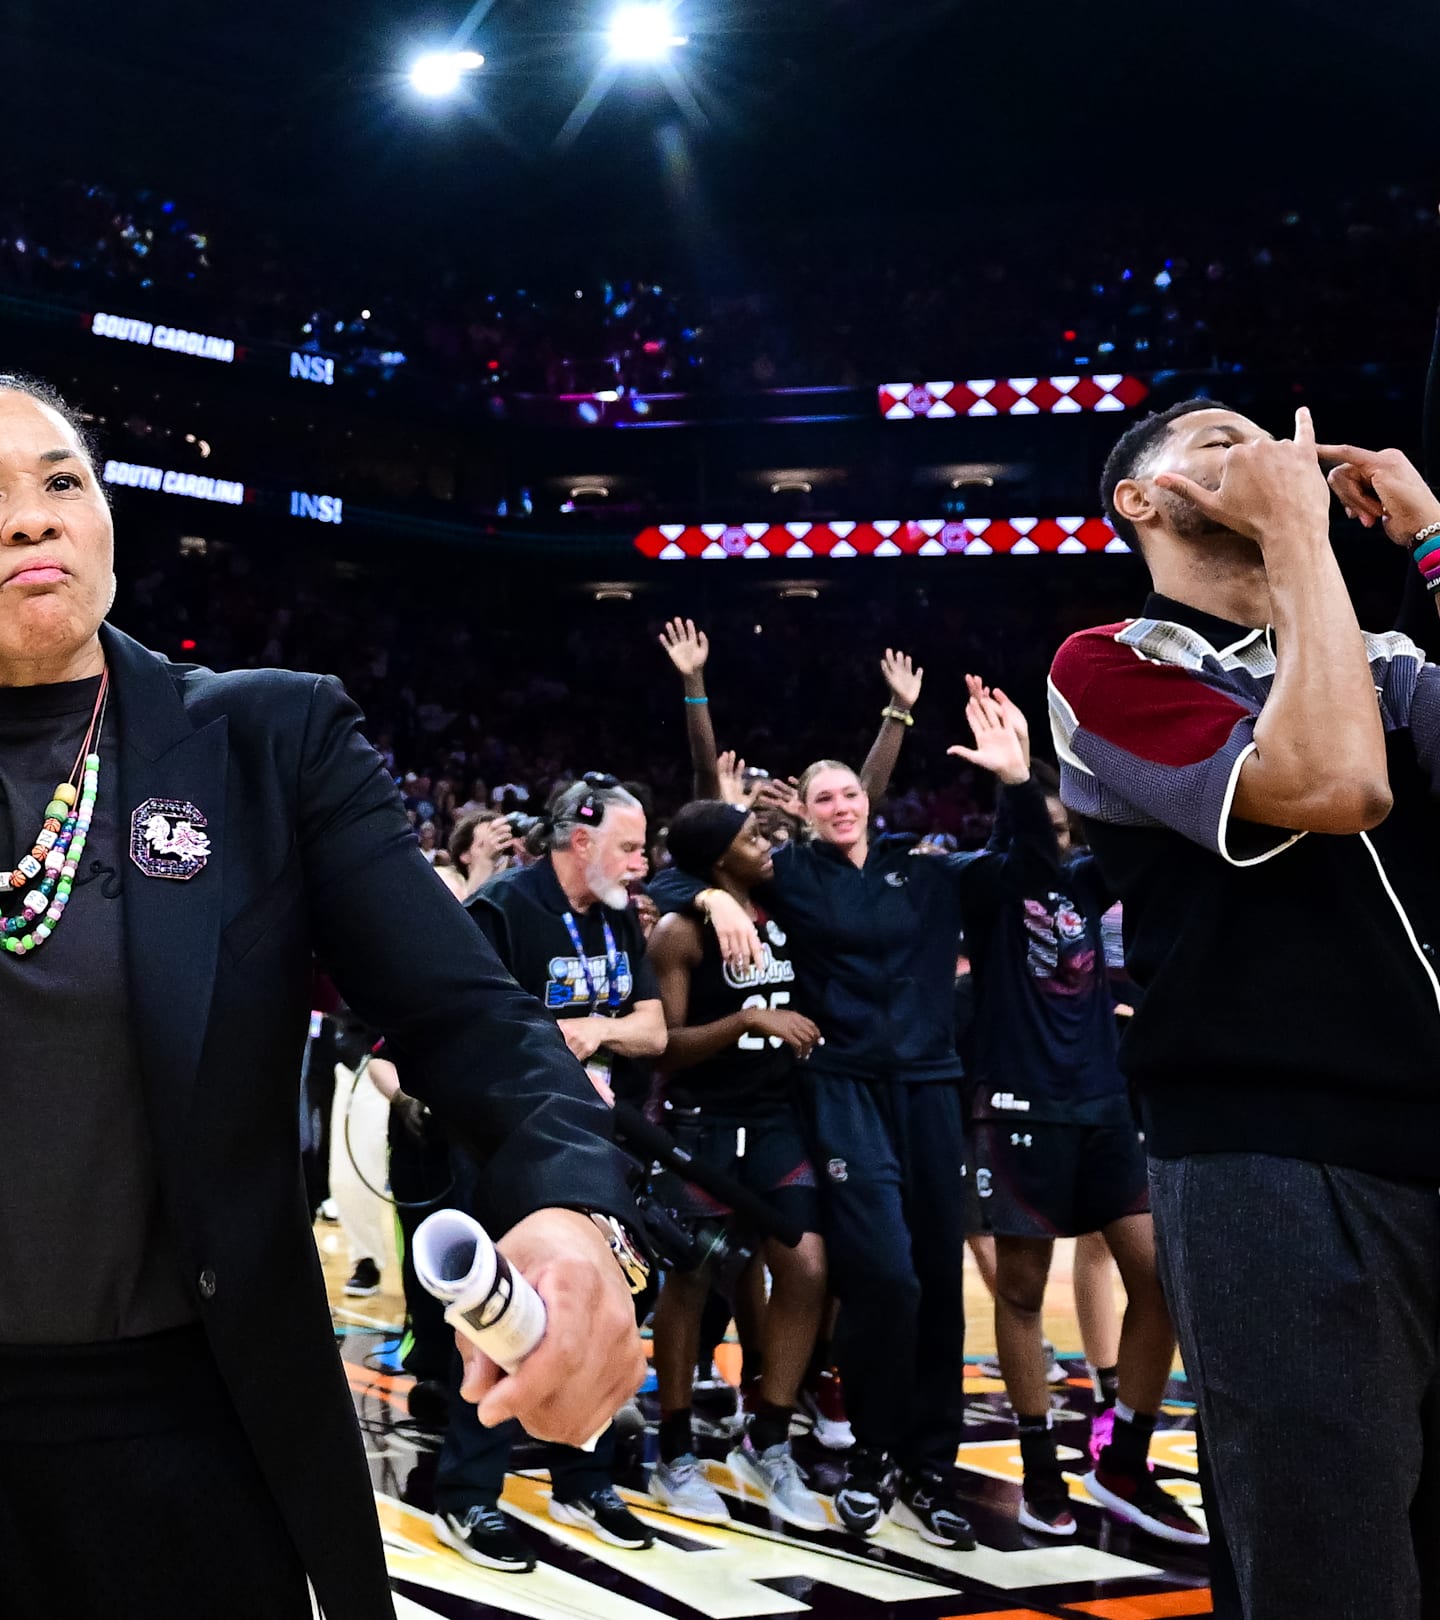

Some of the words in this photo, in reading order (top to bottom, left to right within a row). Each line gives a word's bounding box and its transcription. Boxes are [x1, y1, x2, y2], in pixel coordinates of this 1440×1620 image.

[91, 312, 153, 345] SOUTH
[152, 325, 235, 363] CAROLINA
[103, 460, 163, 491] SOUTH
[162, 471, 244, 505] CAROLINA
